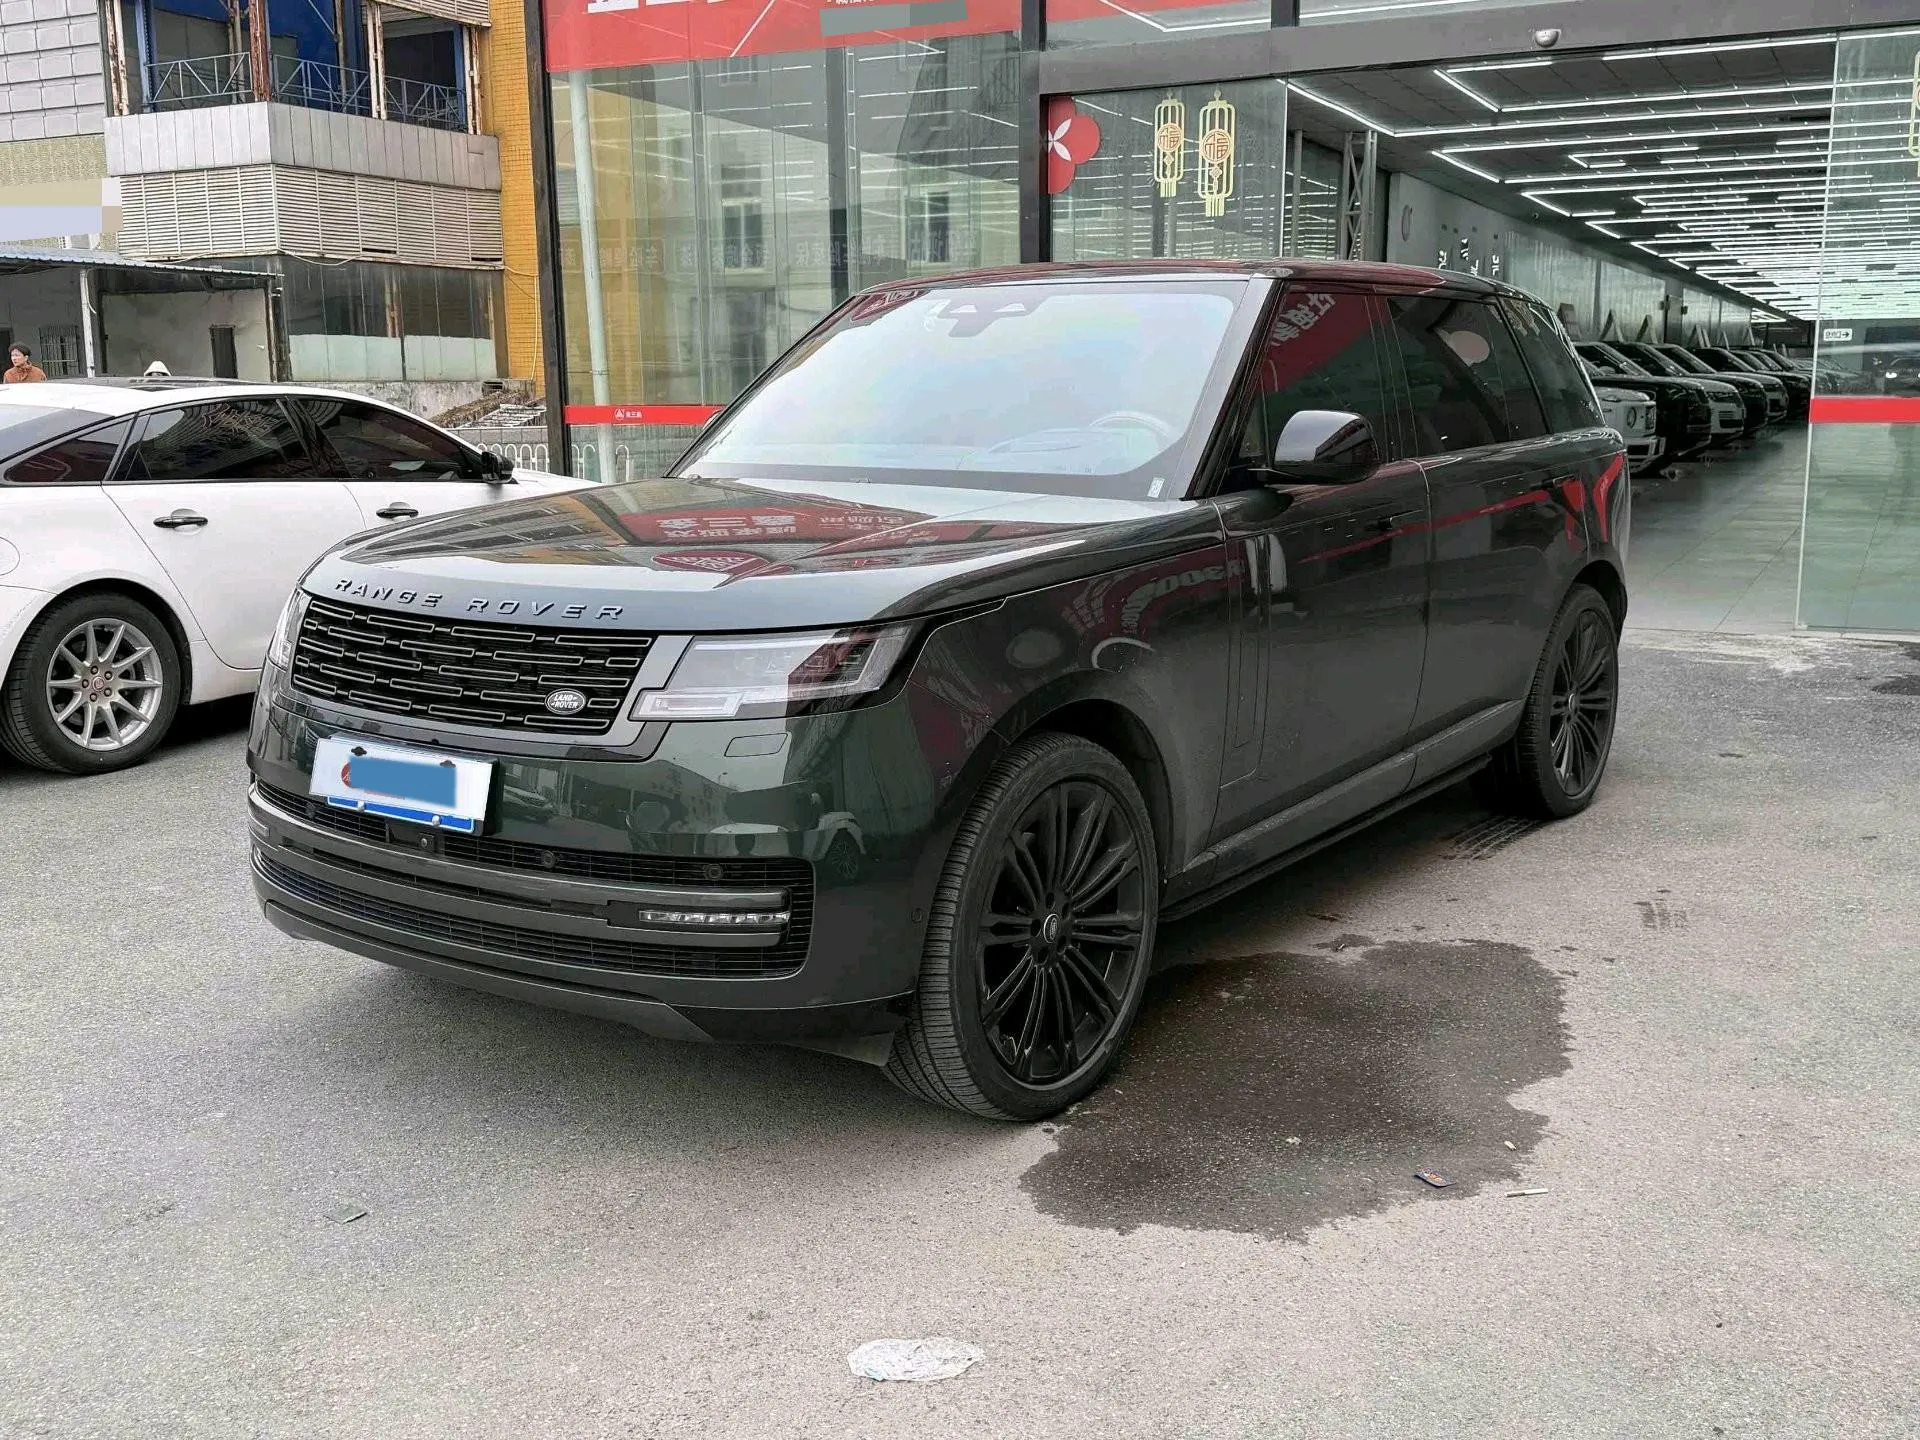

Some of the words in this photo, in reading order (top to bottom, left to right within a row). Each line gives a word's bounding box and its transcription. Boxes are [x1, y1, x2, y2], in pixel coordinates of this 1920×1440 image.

[1204, 131, 1229, 161] 福
[335, 578, 443, 608] RANGE
[466, 597, 624, 620] ROVER
[553, 693, 574, 701] LAND
[553, 700, 579, 709] ROVER
